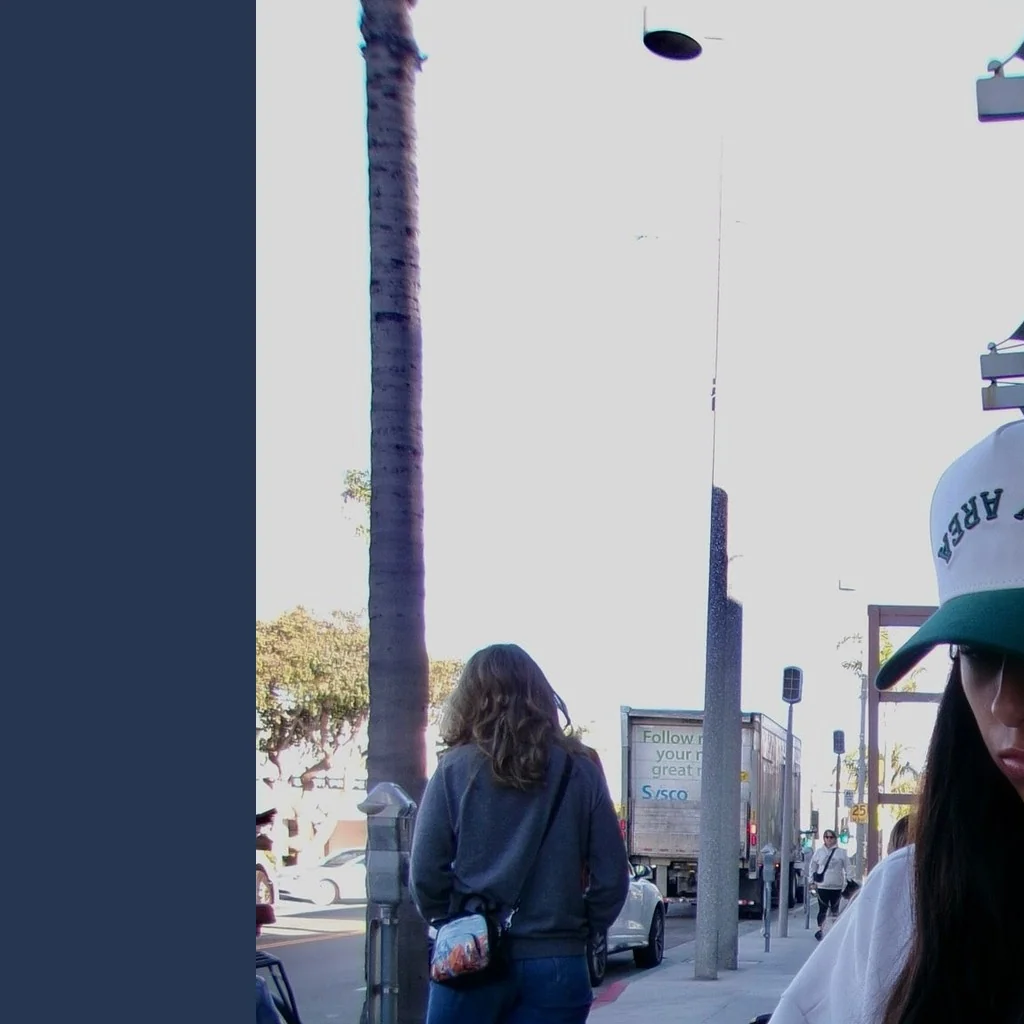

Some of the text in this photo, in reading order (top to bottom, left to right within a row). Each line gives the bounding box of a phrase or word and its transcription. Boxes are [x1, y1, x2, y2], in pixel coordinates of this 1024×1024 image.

[937, 488, 1004, 565] AREA
[643, 730, 694, 745] Follow
[656, 749, 692, 763] your
[652, 764, 692, 779] great
[852, 804, 866, 816] 25
